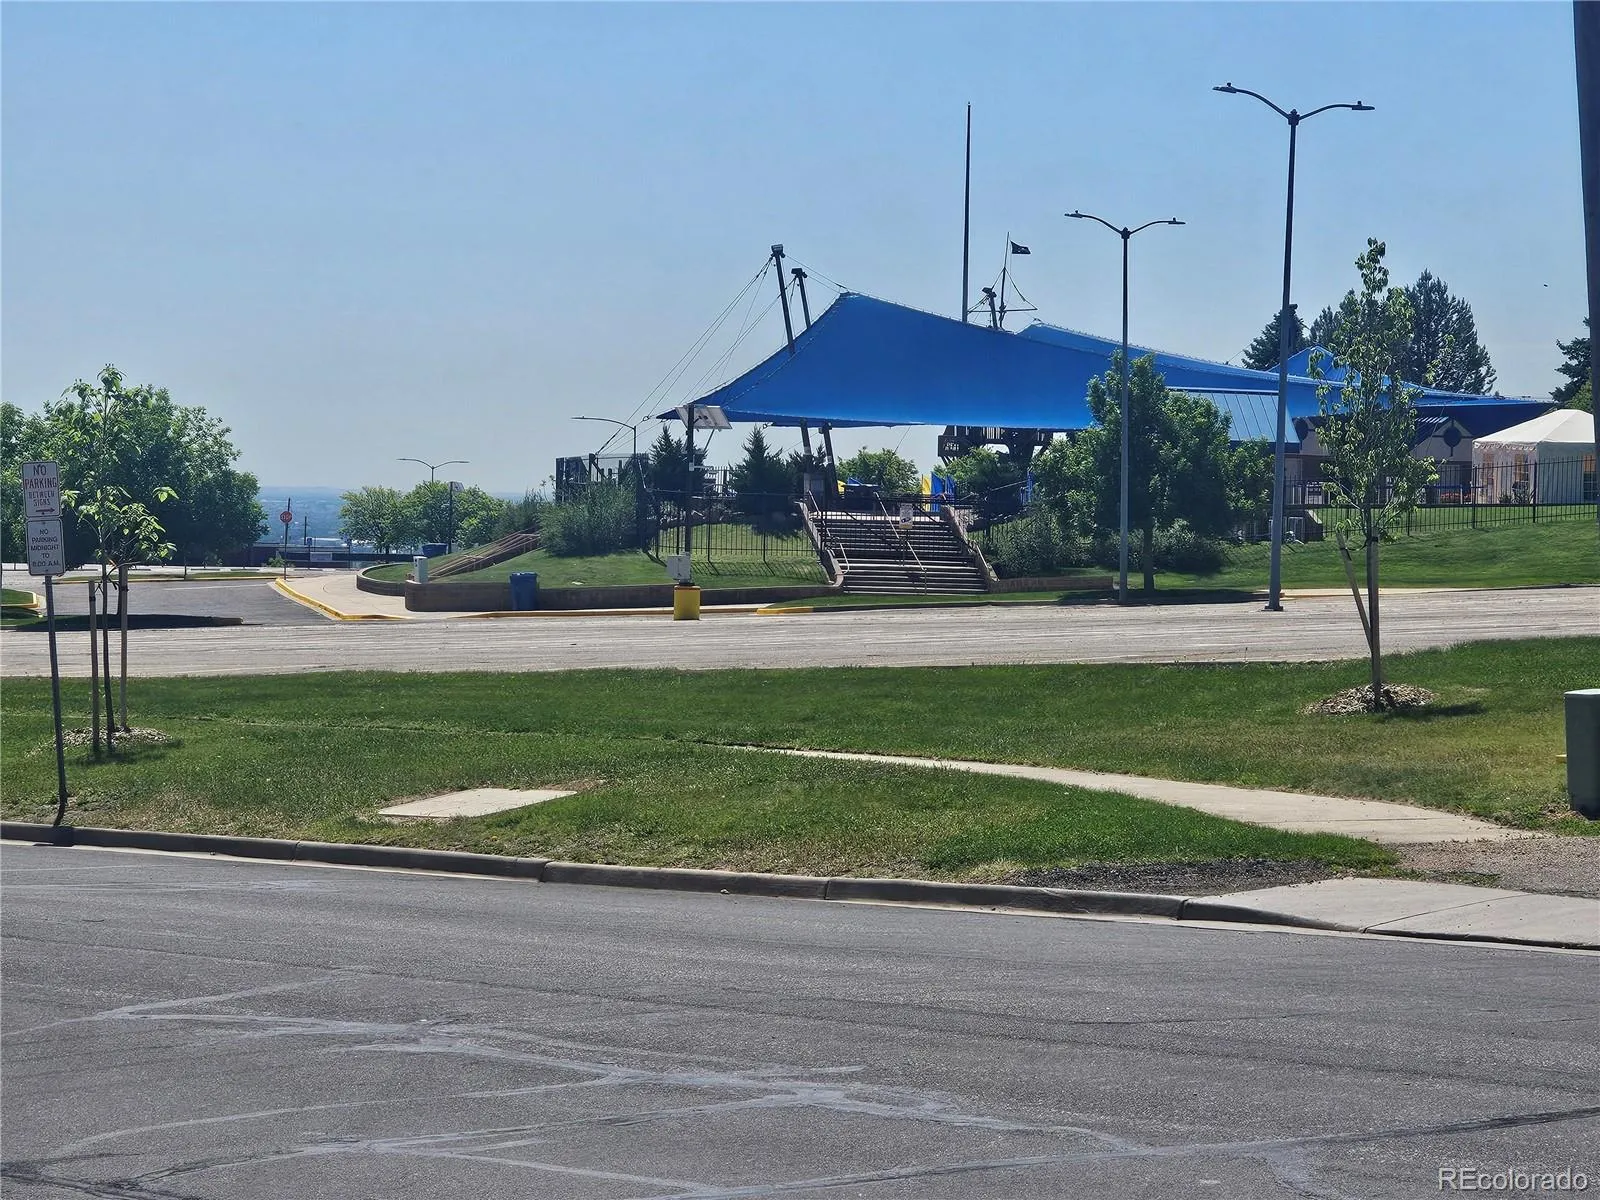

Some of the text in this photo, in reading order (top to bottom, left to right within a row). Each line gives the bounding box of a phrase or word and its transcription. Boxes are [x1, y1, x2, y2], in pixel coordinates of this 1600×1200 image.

[33, 465, 47, 475] NO
[25, 477, 57, 489] PARKING
[28, 490, 55, 499] BETWEEN
[33, 499, 50, 507] SIGNS
